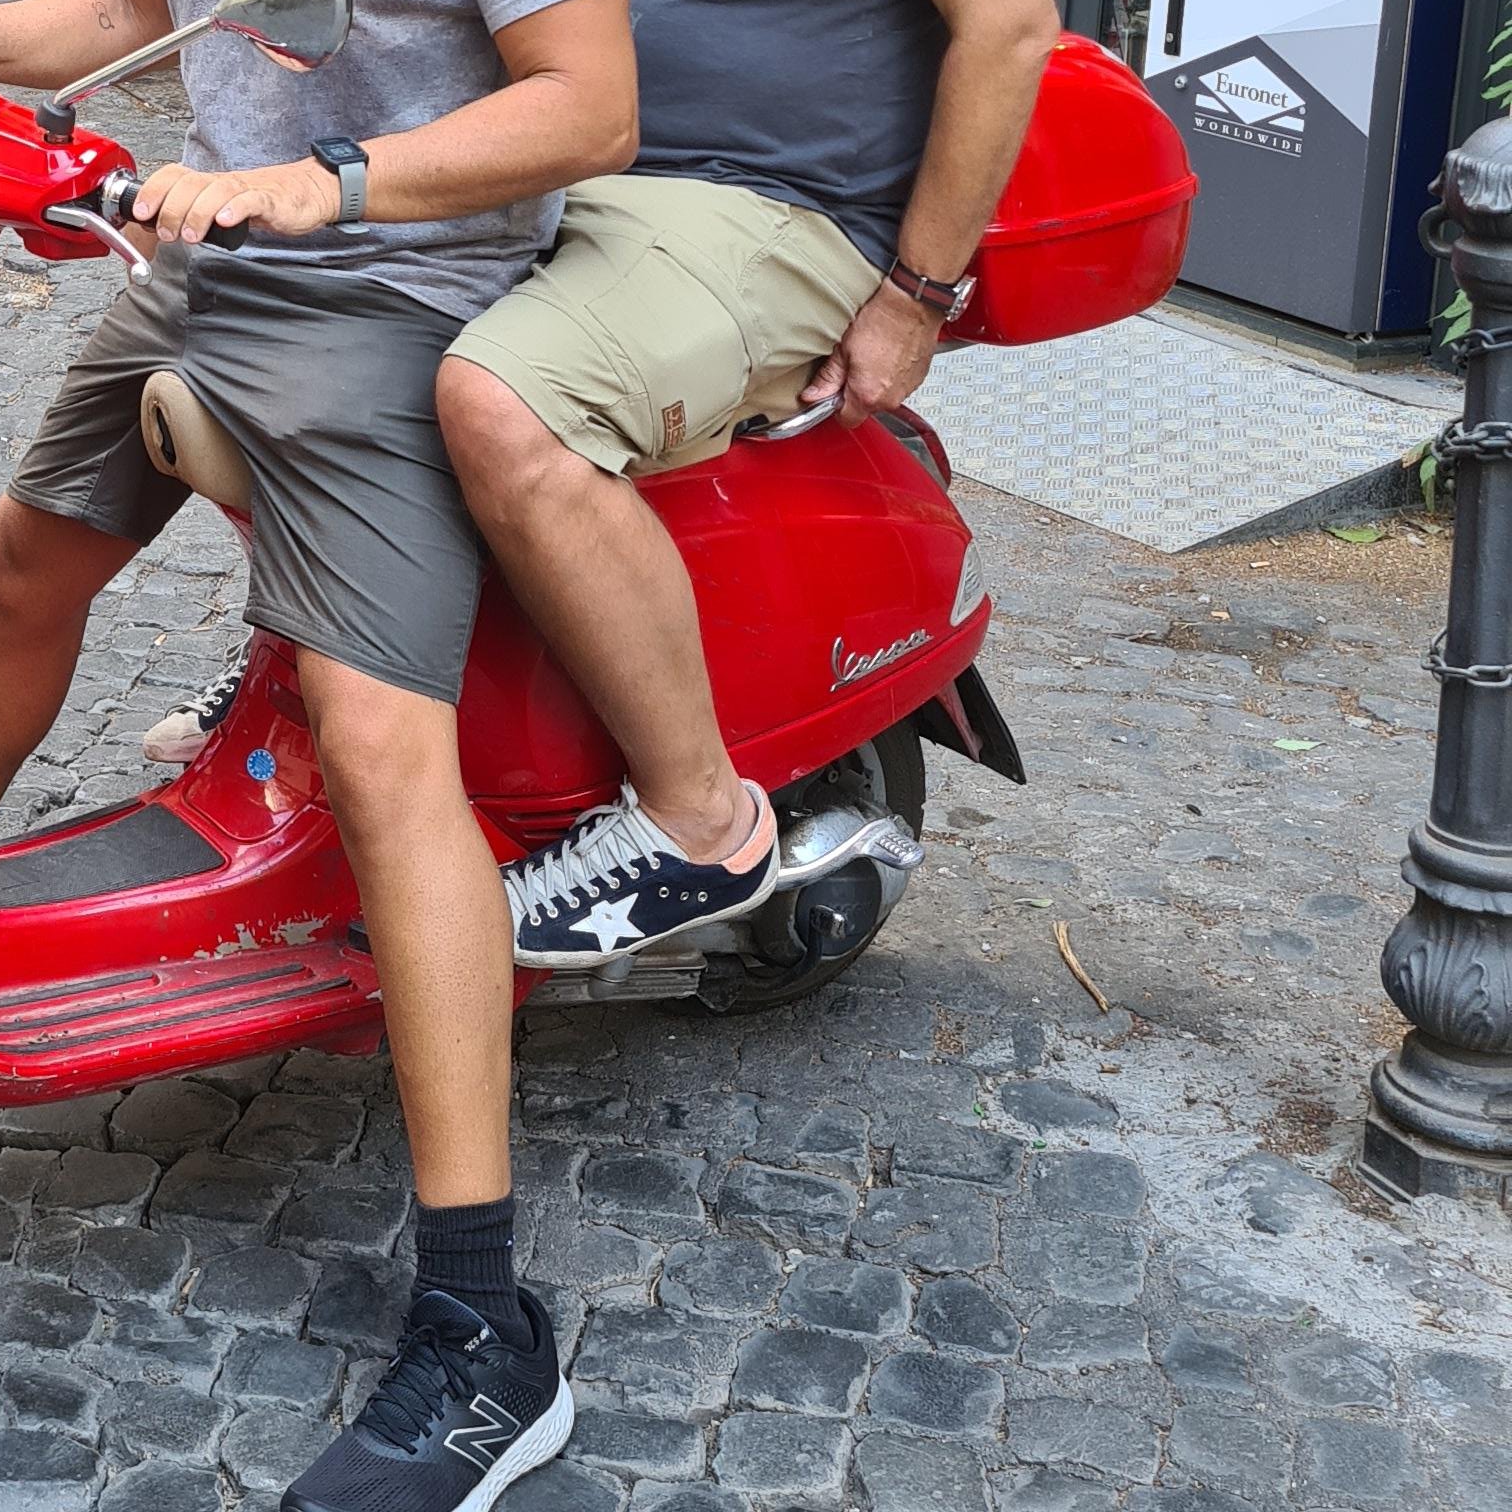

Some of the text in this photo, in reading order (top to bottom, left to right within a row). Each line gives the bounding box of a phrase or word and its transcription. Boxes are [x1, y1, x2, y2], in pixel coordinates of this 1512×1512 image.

[1214, 71, 1289, 109] Euronet
[1194, 117, 1303, 154] WORLDWIDE
[829, 628, 935, 693] Vespa
